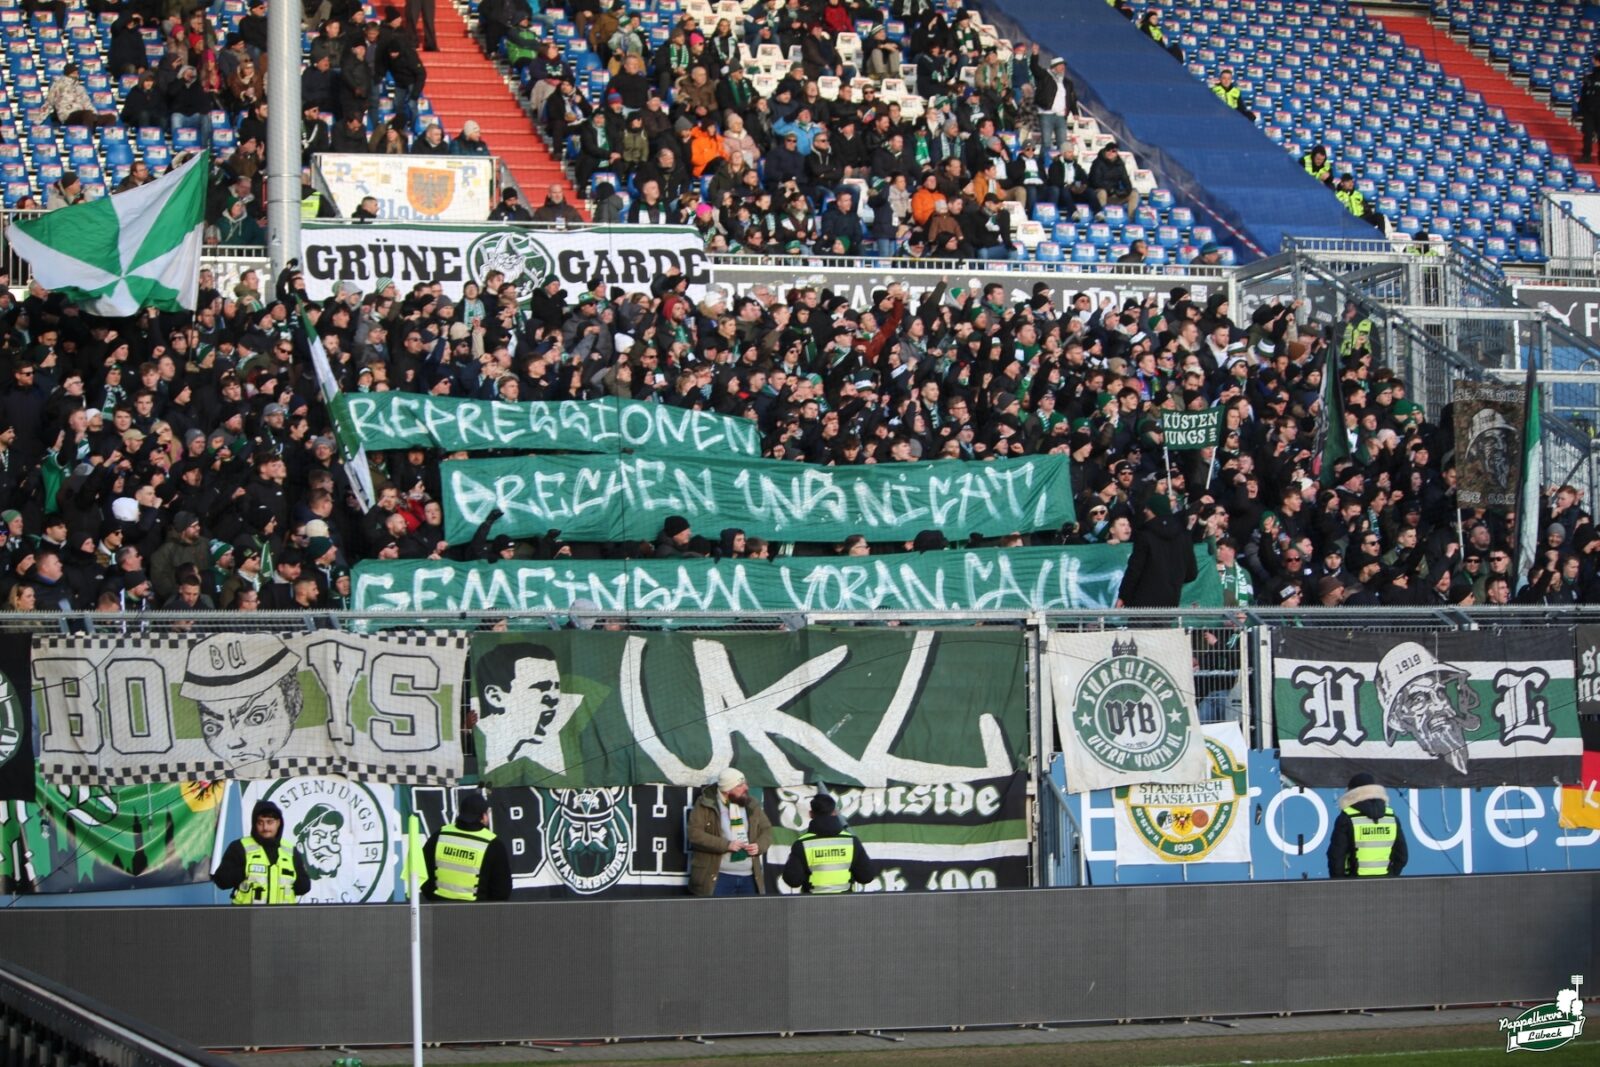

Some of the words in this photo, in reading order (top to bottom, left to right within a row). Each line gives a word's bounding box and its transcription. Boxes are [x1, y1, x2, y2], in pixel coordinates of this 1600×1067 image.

[305, 238, 462, 281] GRÜNE
[558, 248, 711, 285] GARDE
[349, 397, 758, 455] REPRESSIONEN
[1163, 411, 1219, 430] KÜSTEN
[1164, 429, 1206, 445] JUNGS
[450, 458, 715, 527] BRECHEN
[734, 467, 848, 528] UNS
[854, 460, 1047, 527] NICHT,
[355, 563, 762, 613] GEMEINSAM
[209, 640, 246, 671] BU
[1396, 654, 1421, 674] 1919
[619, 630, 1013, 787] UKL
[1134, 745, 1174, 768] YOUTH
[1140, 781, 1223, 794] STAMMTISCH
[1143, 789, 1220, 805] HANSEATEN
[279, 780, 375, 832] STENJUNGS
[364, 847, 378, 860] 19
[1174, 843, 1194, 853] 1919
[550, 840, 628, 889] VITALIENBRÜDER
